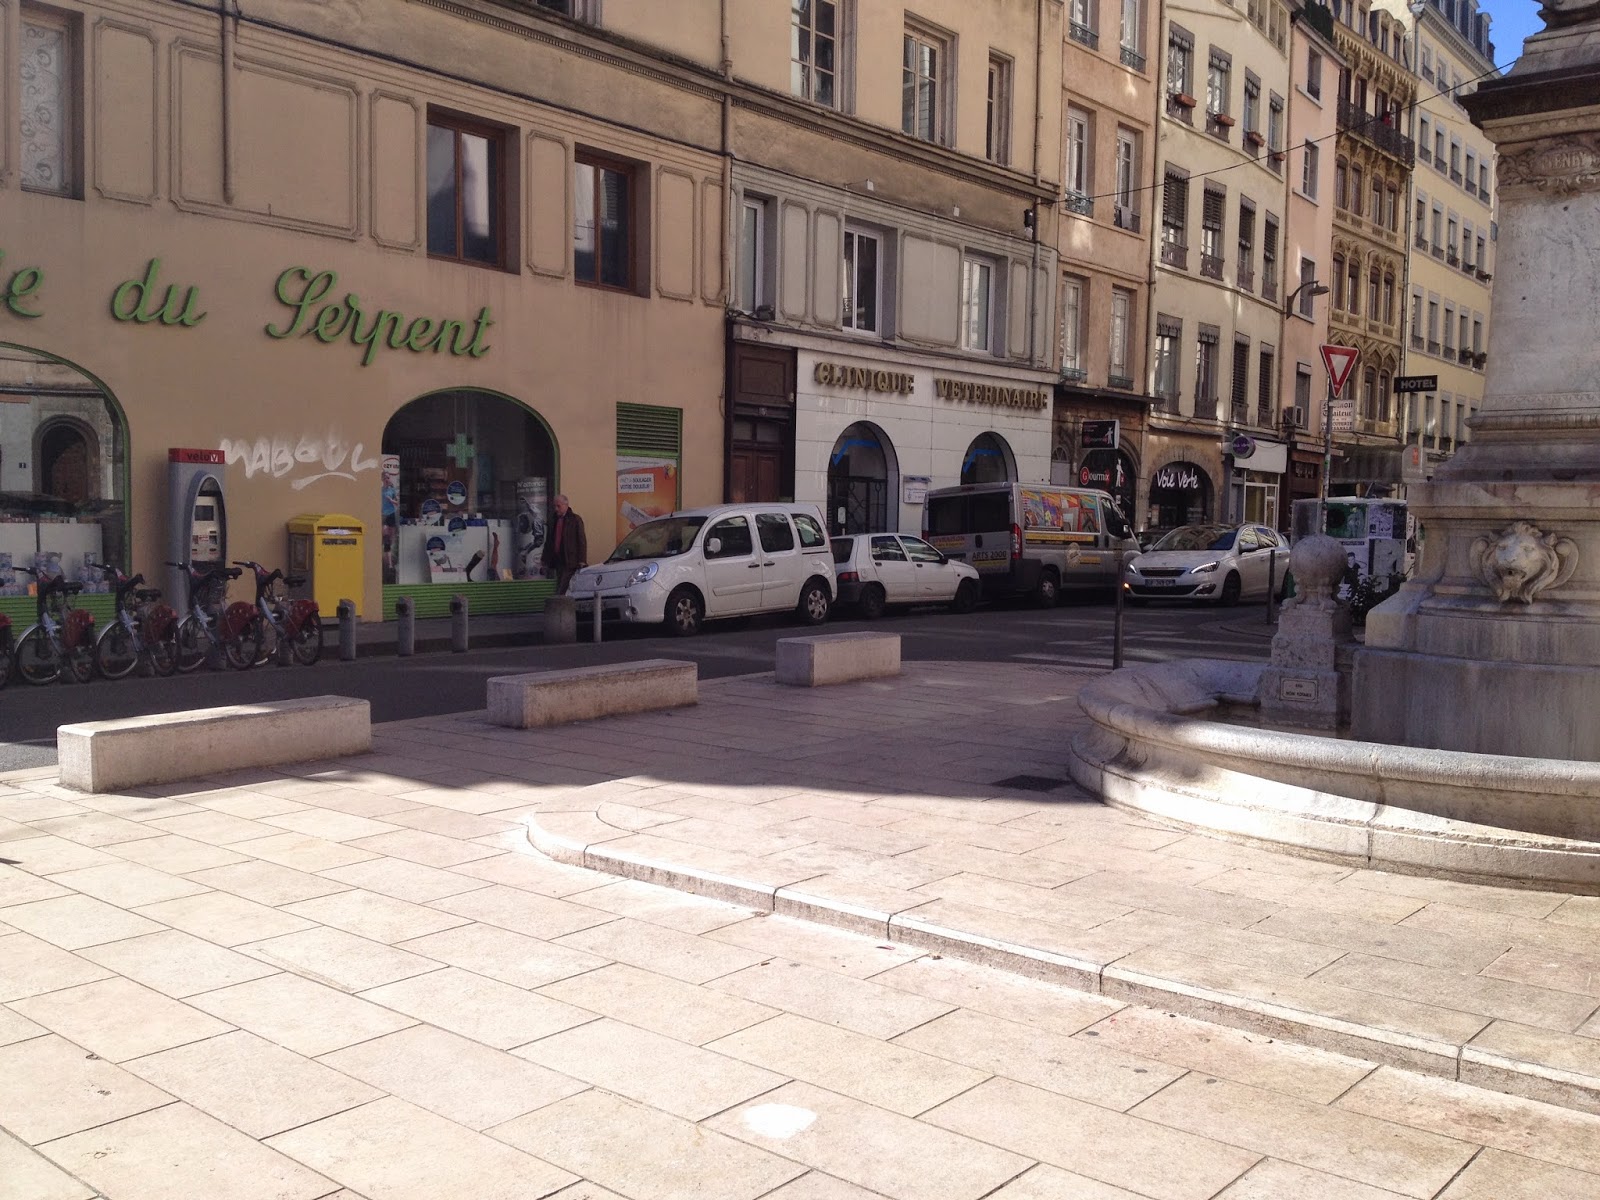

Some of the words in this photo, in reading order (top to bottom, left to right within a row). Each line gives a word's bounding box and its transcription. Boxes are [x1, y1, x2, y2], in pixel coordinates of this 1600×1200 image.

[111, 257, 207, 326] du
[264, 266, 495, 367] Serpent
[814, 361, 914, 394] CLINIQUE
[934, 377, 1048, 409] VETERINAIRE
[1400, 379, 1436, 389] HOTEL
[1157, 469, 1175, 488] Voie
[1178, 468, 1198, 489] Verte
